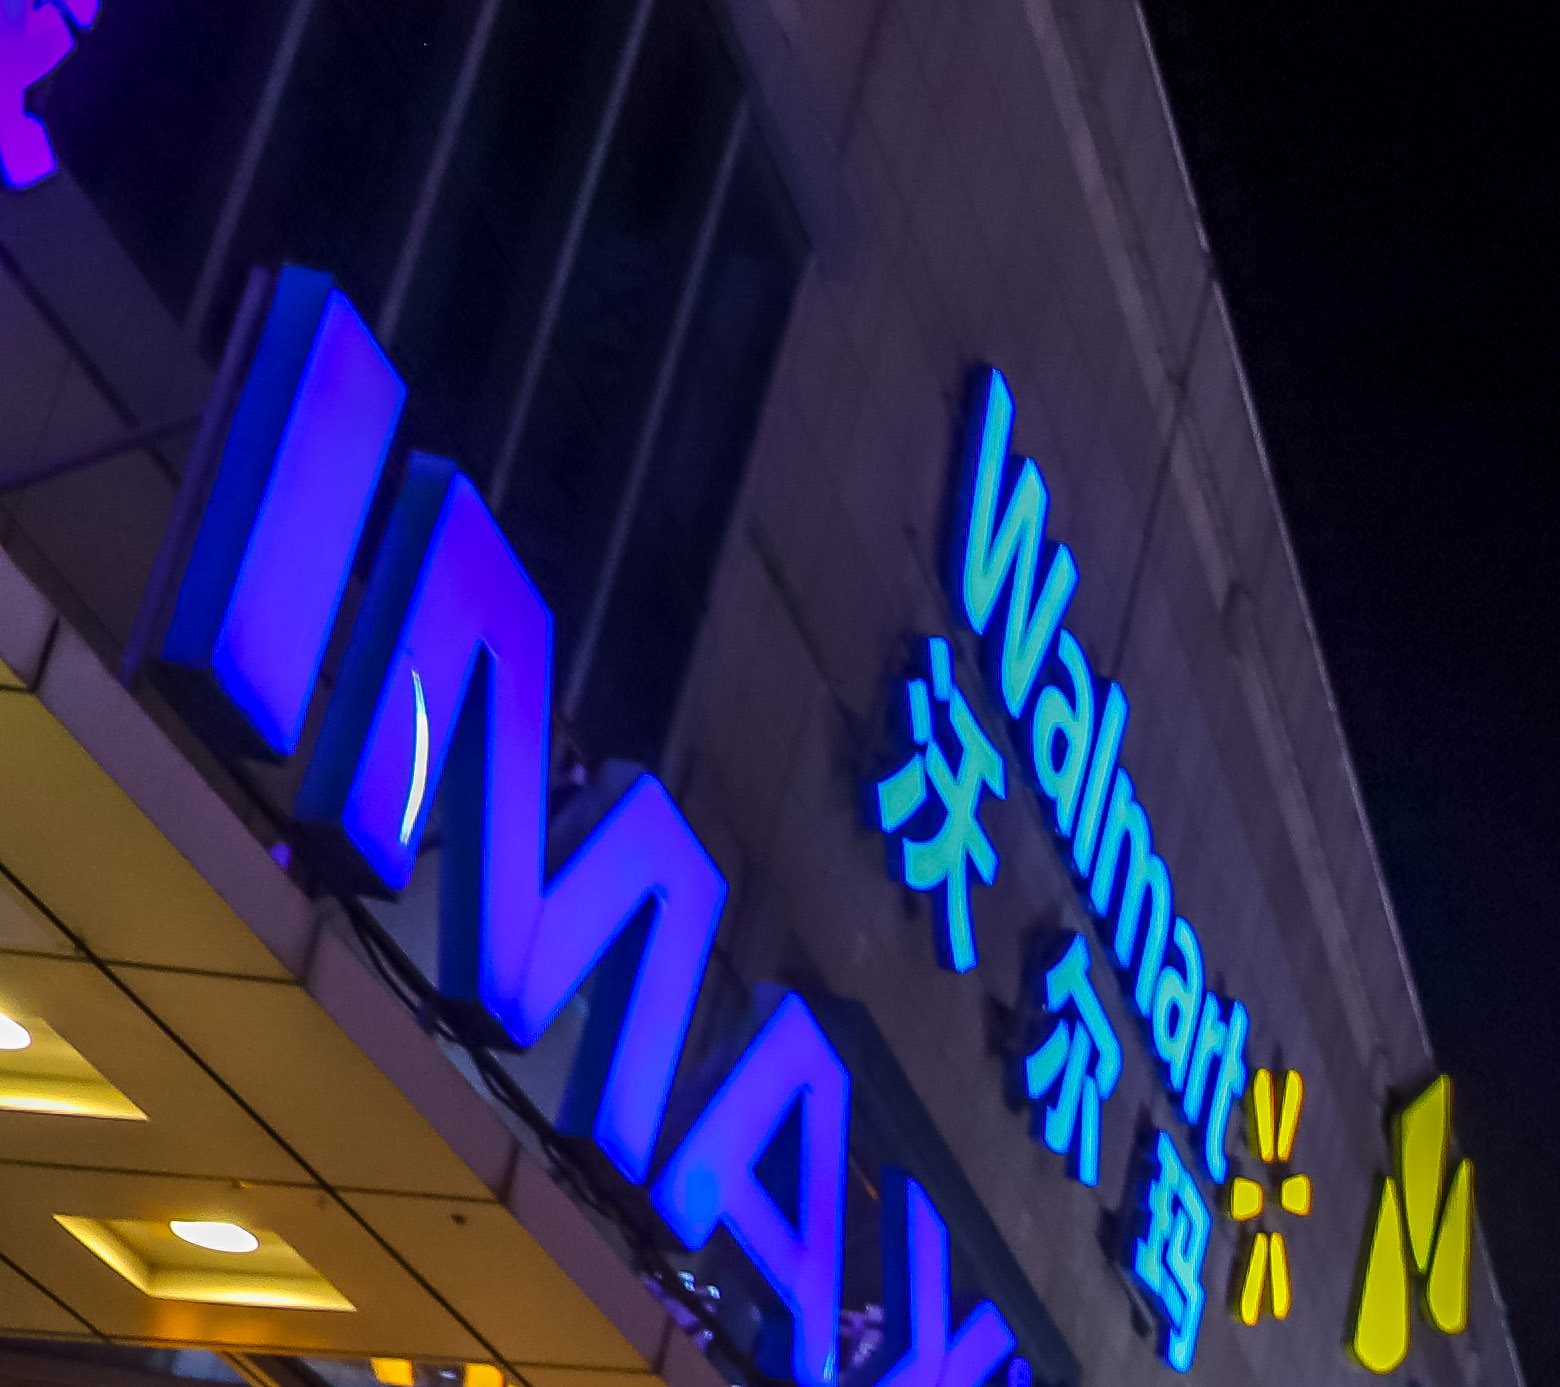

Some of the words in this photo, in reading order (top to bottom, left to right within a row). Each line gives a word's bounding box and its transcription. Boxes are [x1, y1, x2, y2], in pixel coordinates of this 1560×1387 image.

[876, 634, 1213, 1376] 沃尔玛
[962, 366, 1250, 1186] Walmart
